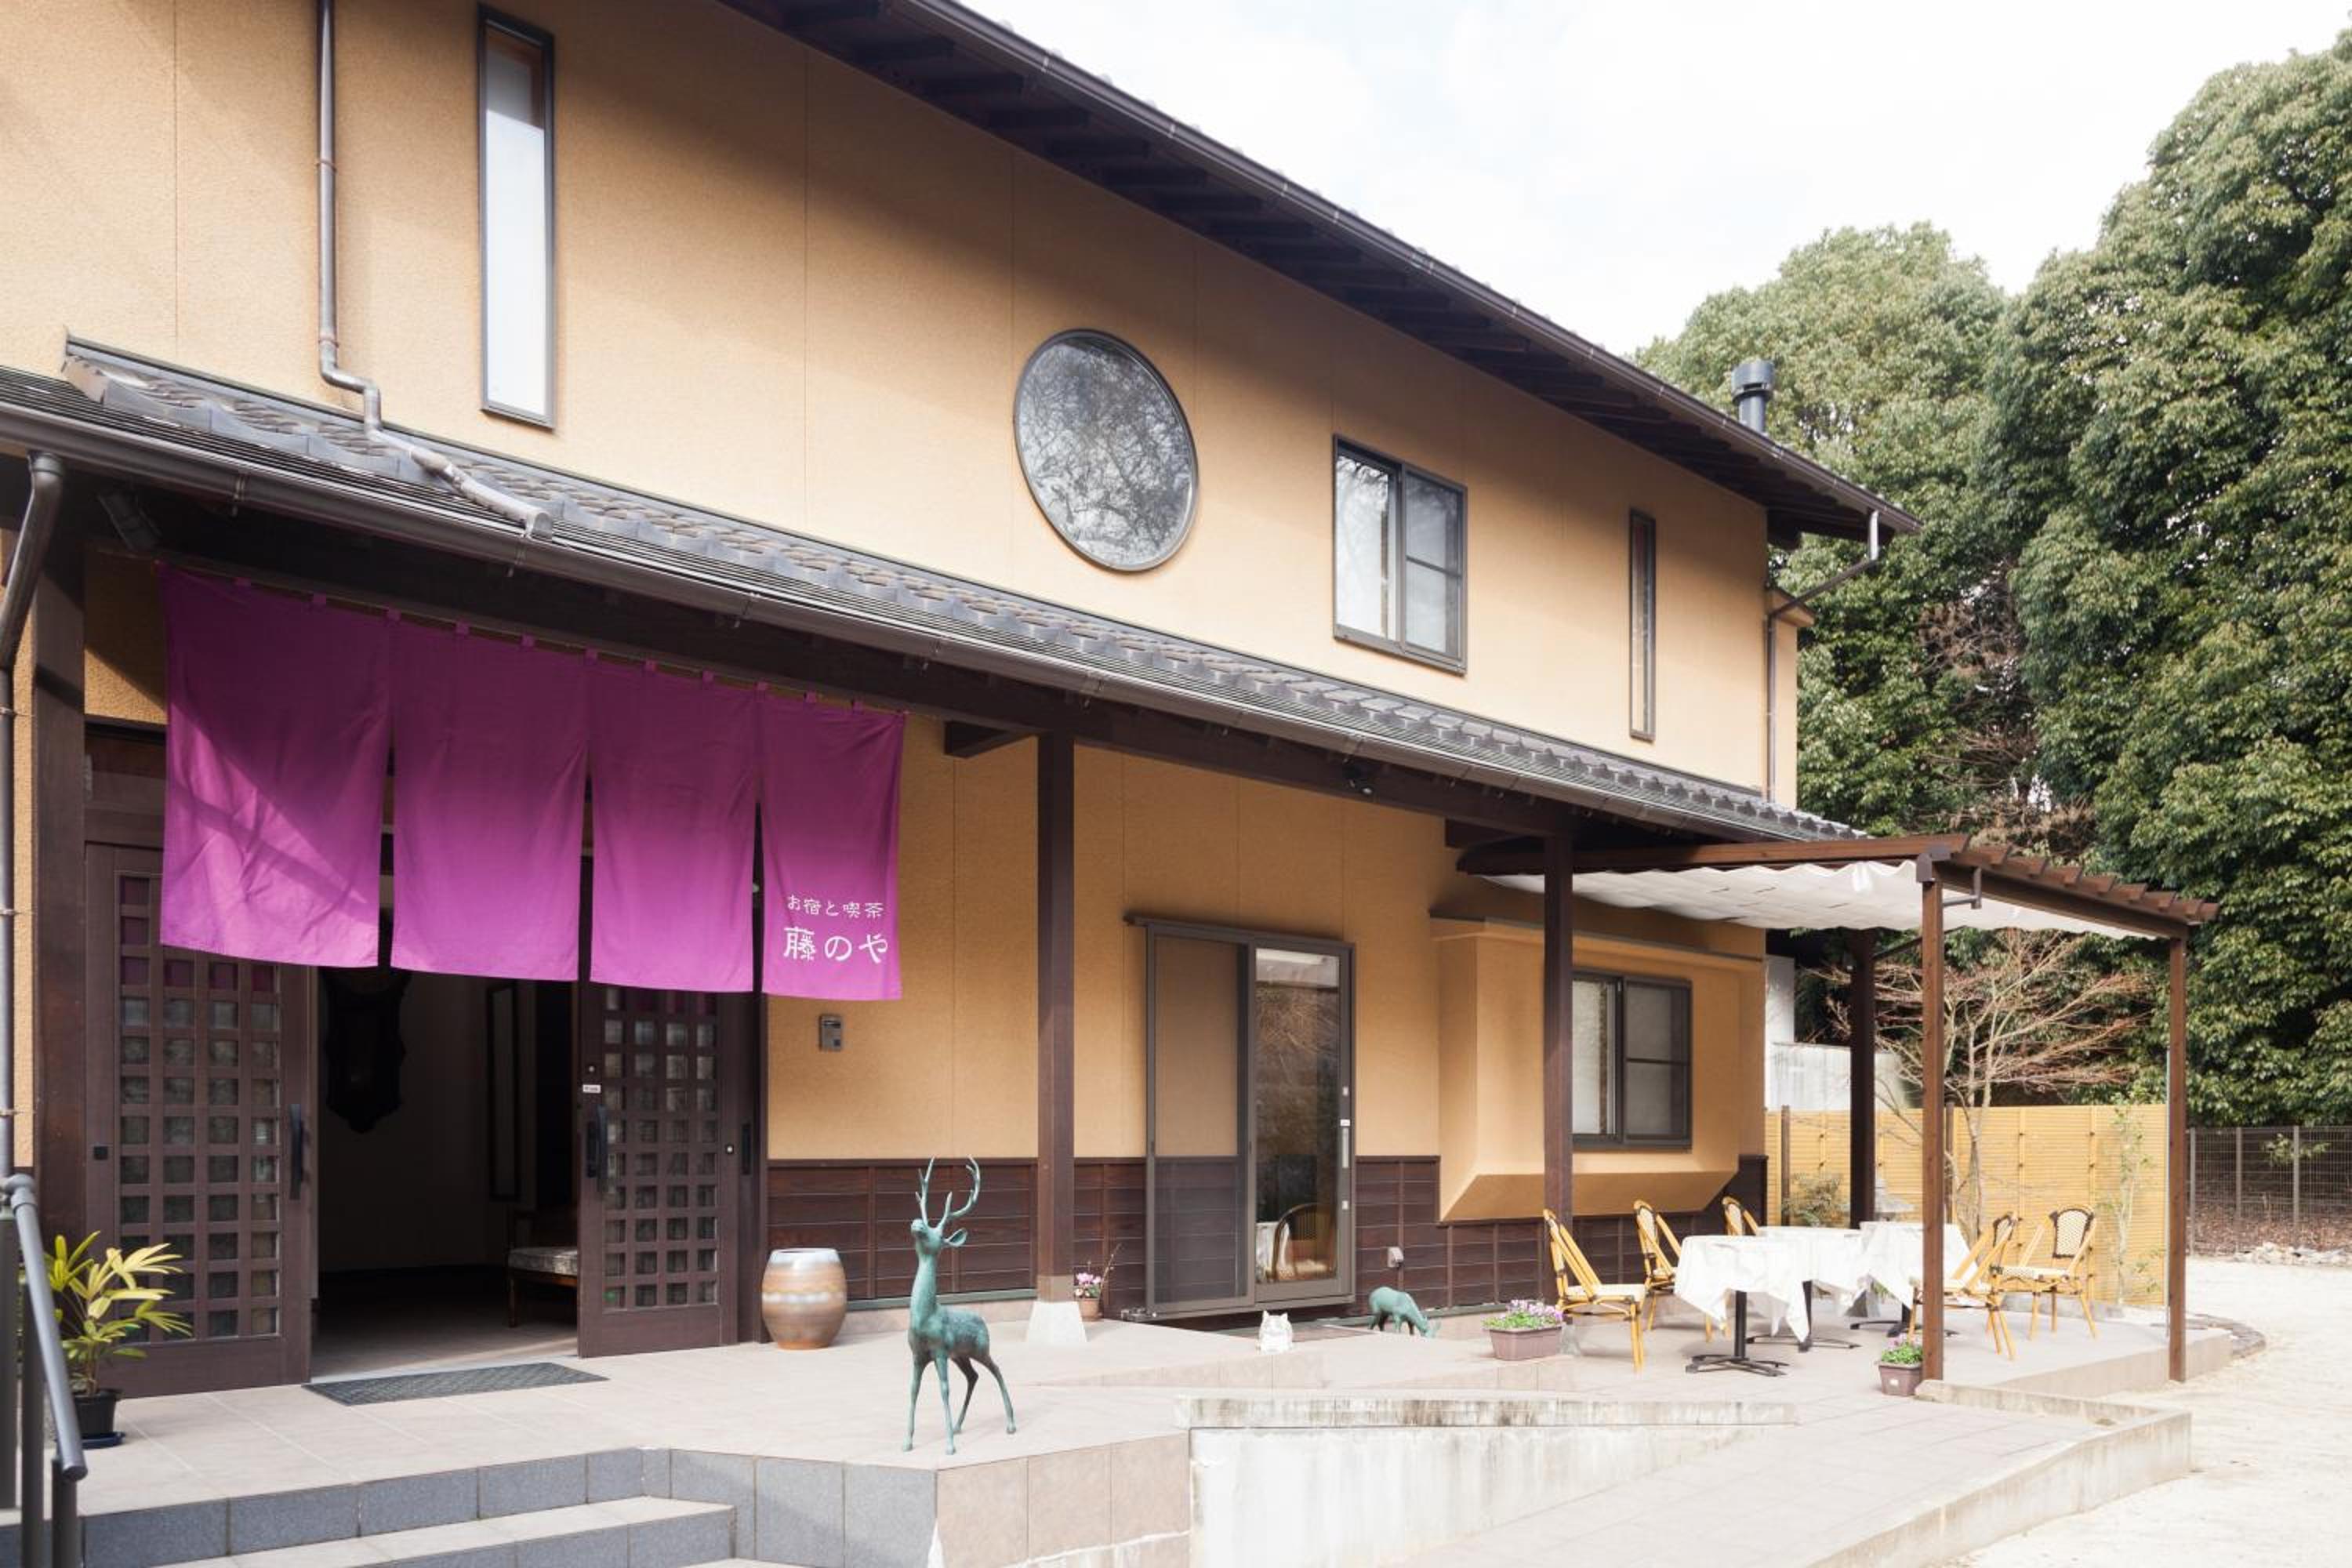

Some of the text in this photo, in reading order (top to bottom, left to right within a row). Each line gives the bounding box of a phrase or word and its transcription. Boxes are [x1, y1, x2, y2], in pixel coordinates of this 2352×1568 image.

[787, 895, 884, 919] お宿と喫茶
[783, 926, 888, 964] 藤のや
